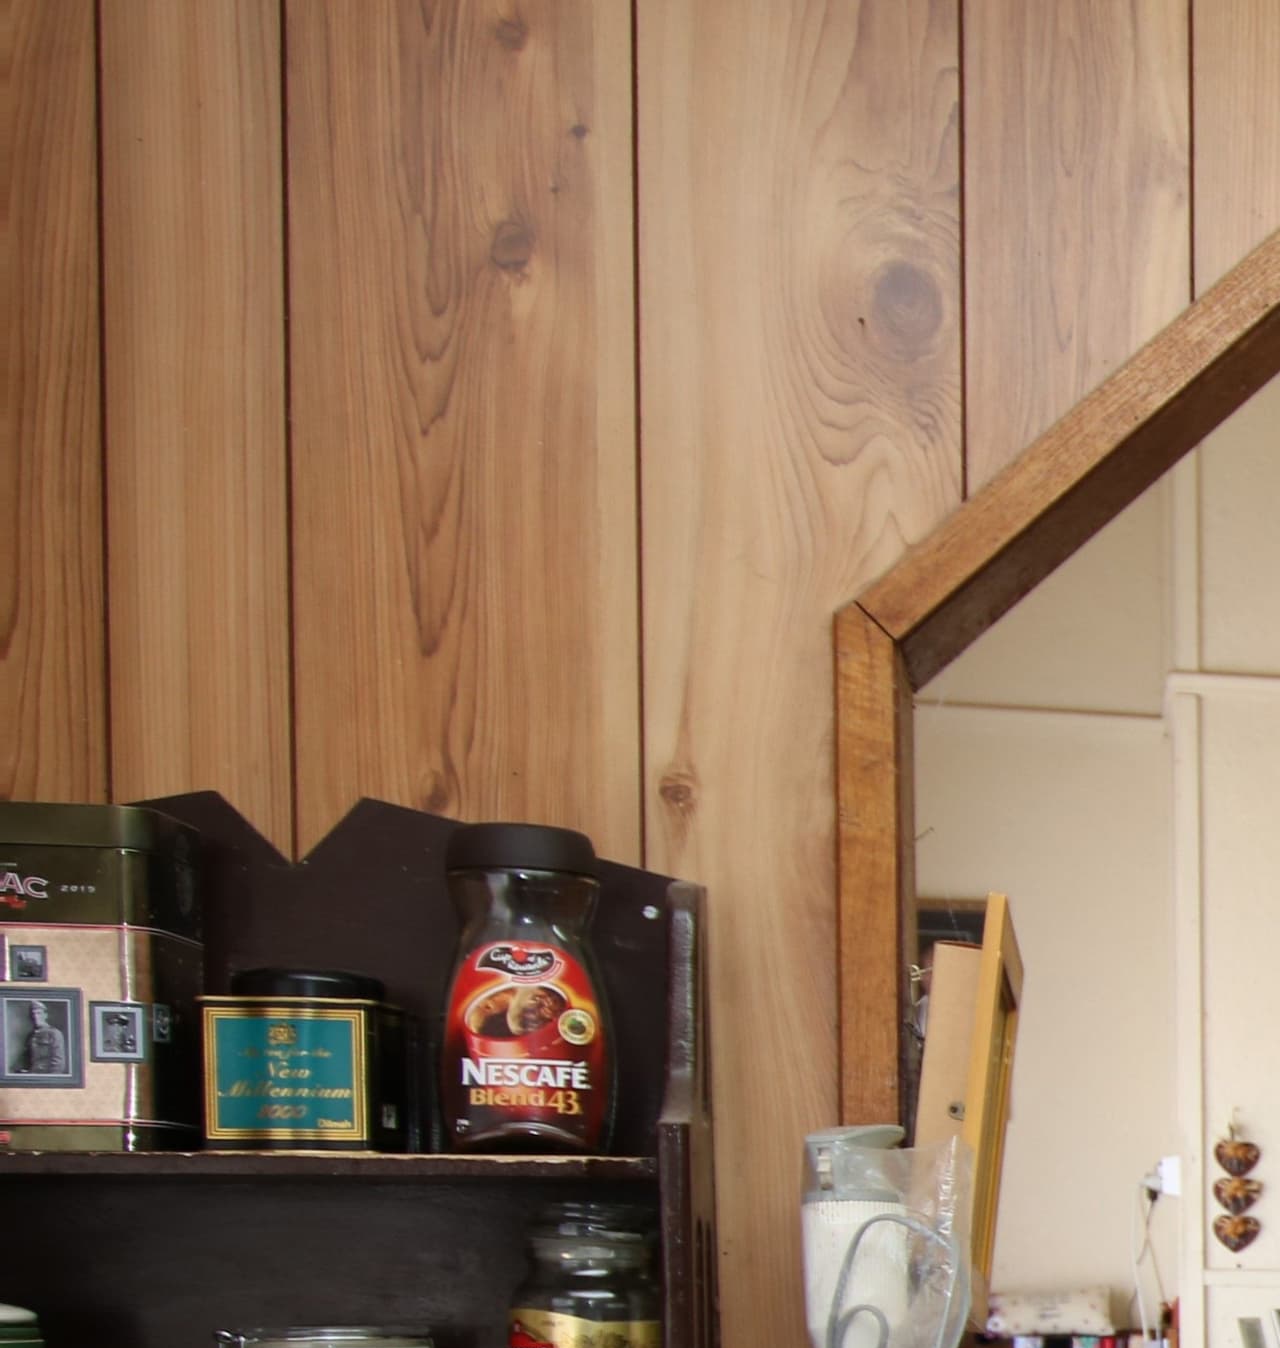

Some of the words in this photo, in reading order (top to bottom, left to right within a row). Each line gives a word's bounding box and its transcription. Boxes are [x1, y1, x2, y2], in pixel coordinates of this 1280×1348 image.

[0, 872, 48, 899] AC
[462, 1057, 591, 1089] NESCAFÉ
[470, 1088, 545, 1106] Blend
[546, 1090, 580, 1115] 43
